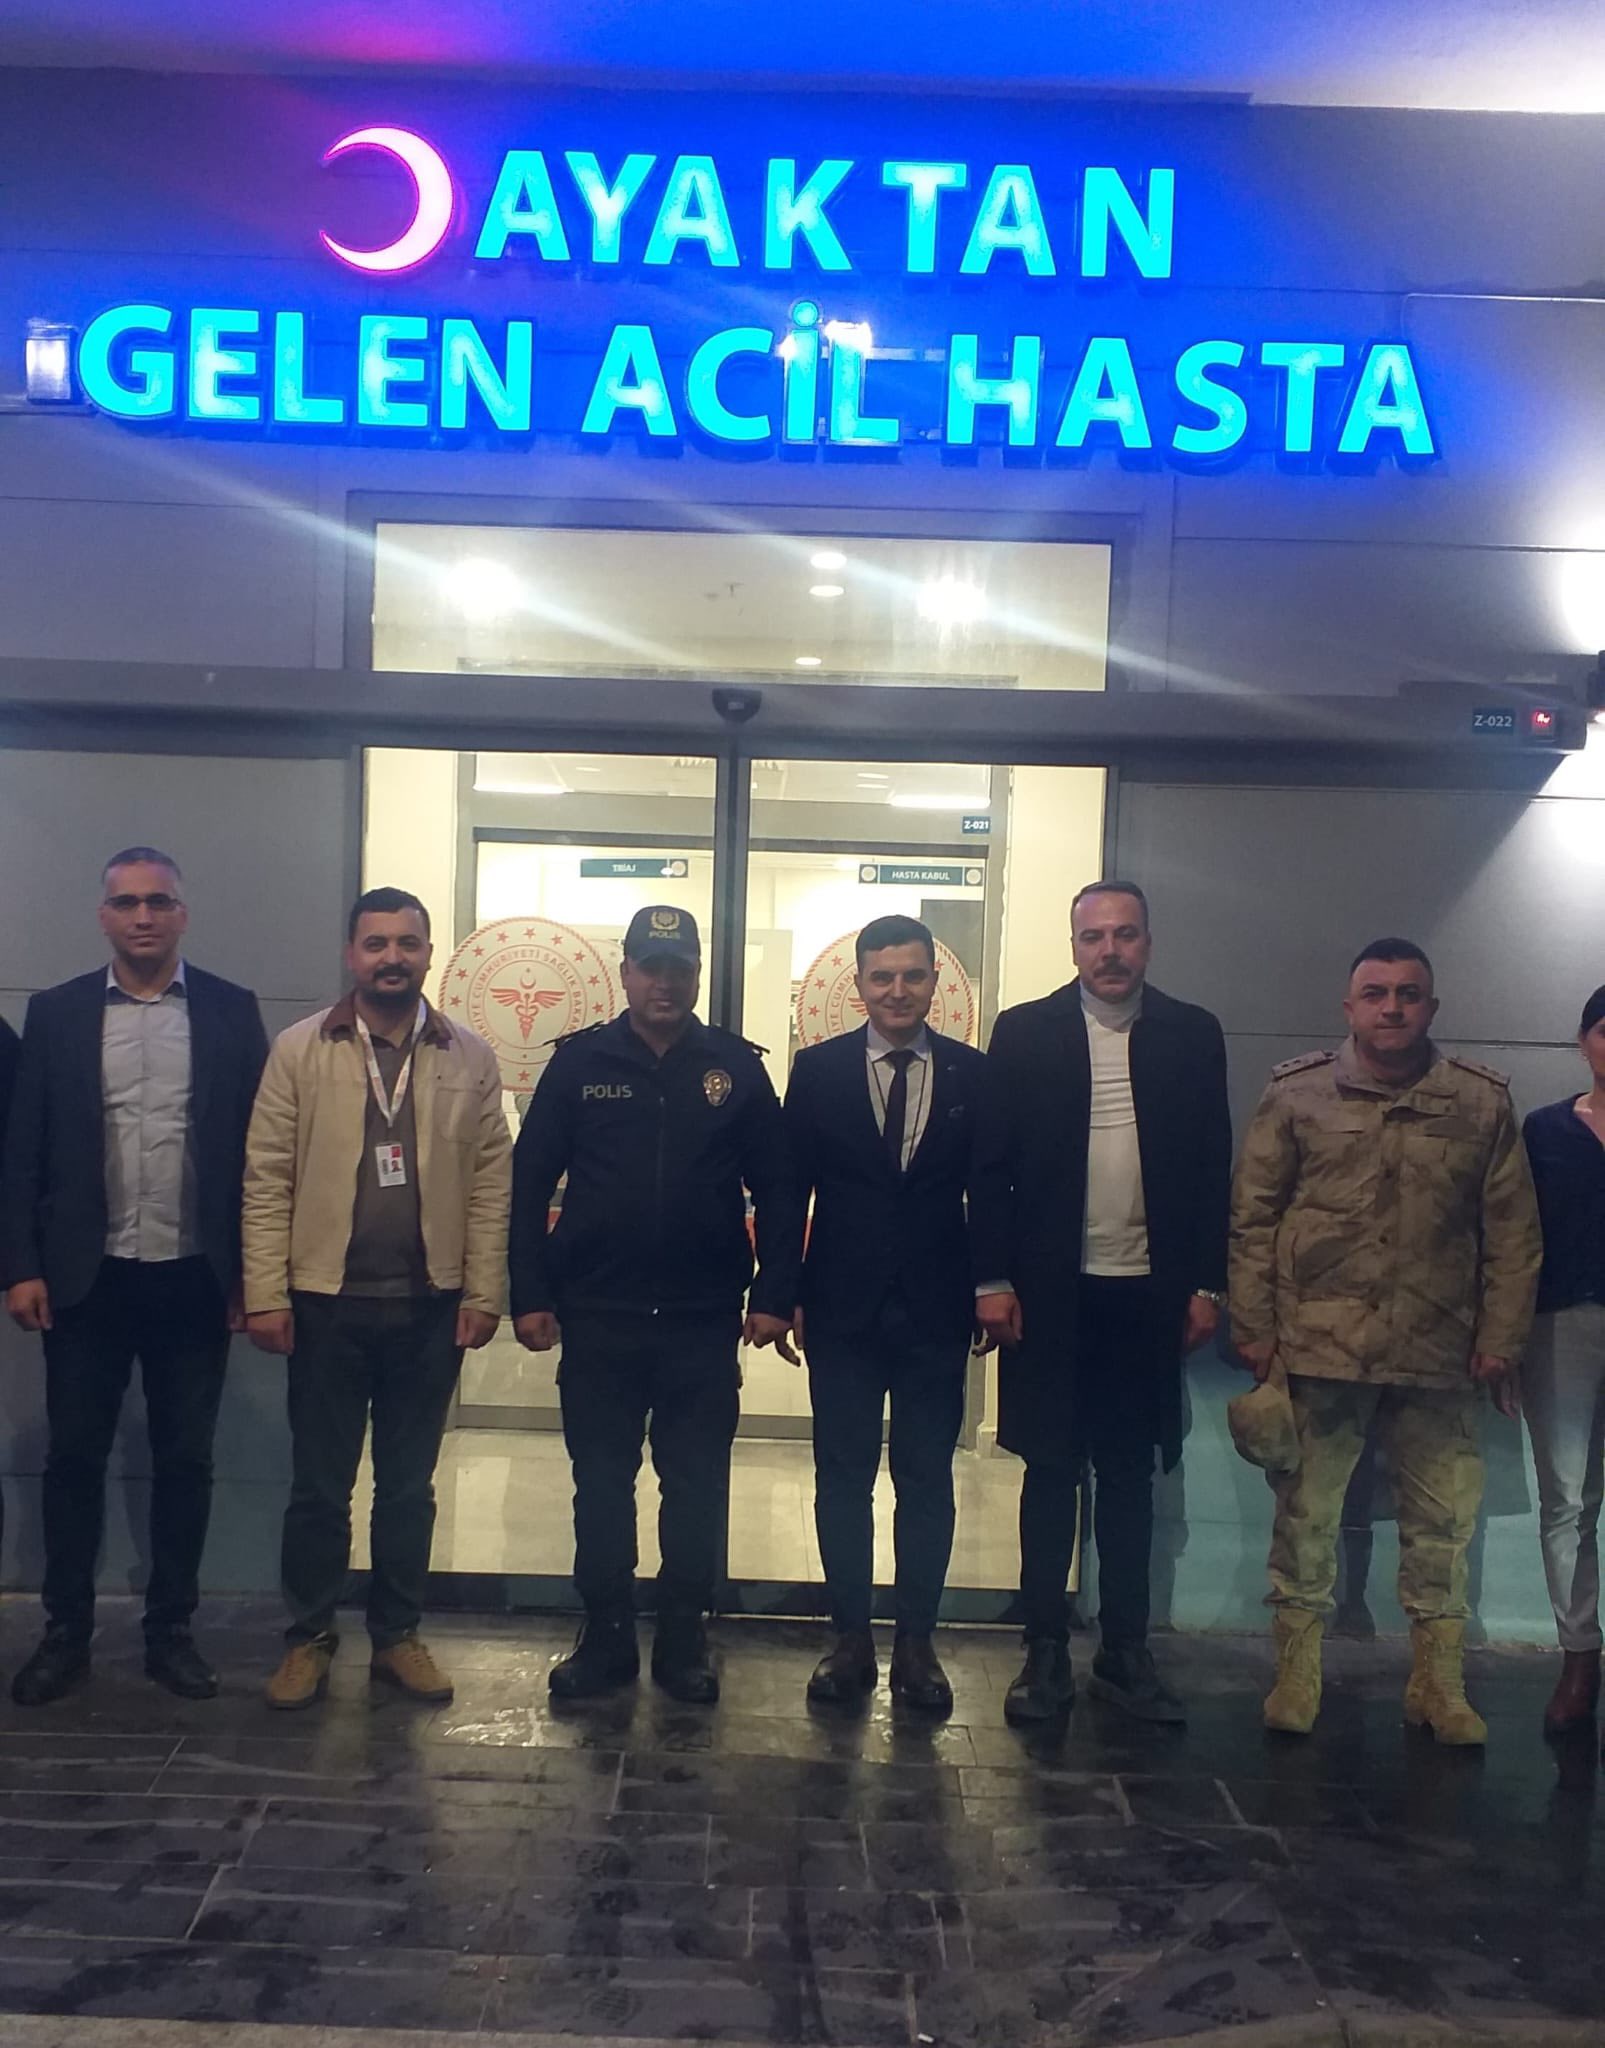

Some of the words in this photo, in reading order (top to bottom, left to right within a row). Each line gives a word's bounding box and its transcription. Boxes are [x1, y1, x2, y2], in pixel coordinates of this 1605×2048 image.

[475, 150, 1175, 278] AYAKTAN
[79, 305, 532, 431] GELEN
[582, 301, 899, 445] ACİL
[947, 334, 1434, 454] HASTA
[1474, 714, 1512, 727] Z-022
[963, 820, 989, 830] Z-021
[891, 870, 920, 880] HASTA
[921, 872, 950, 881] KABUL
